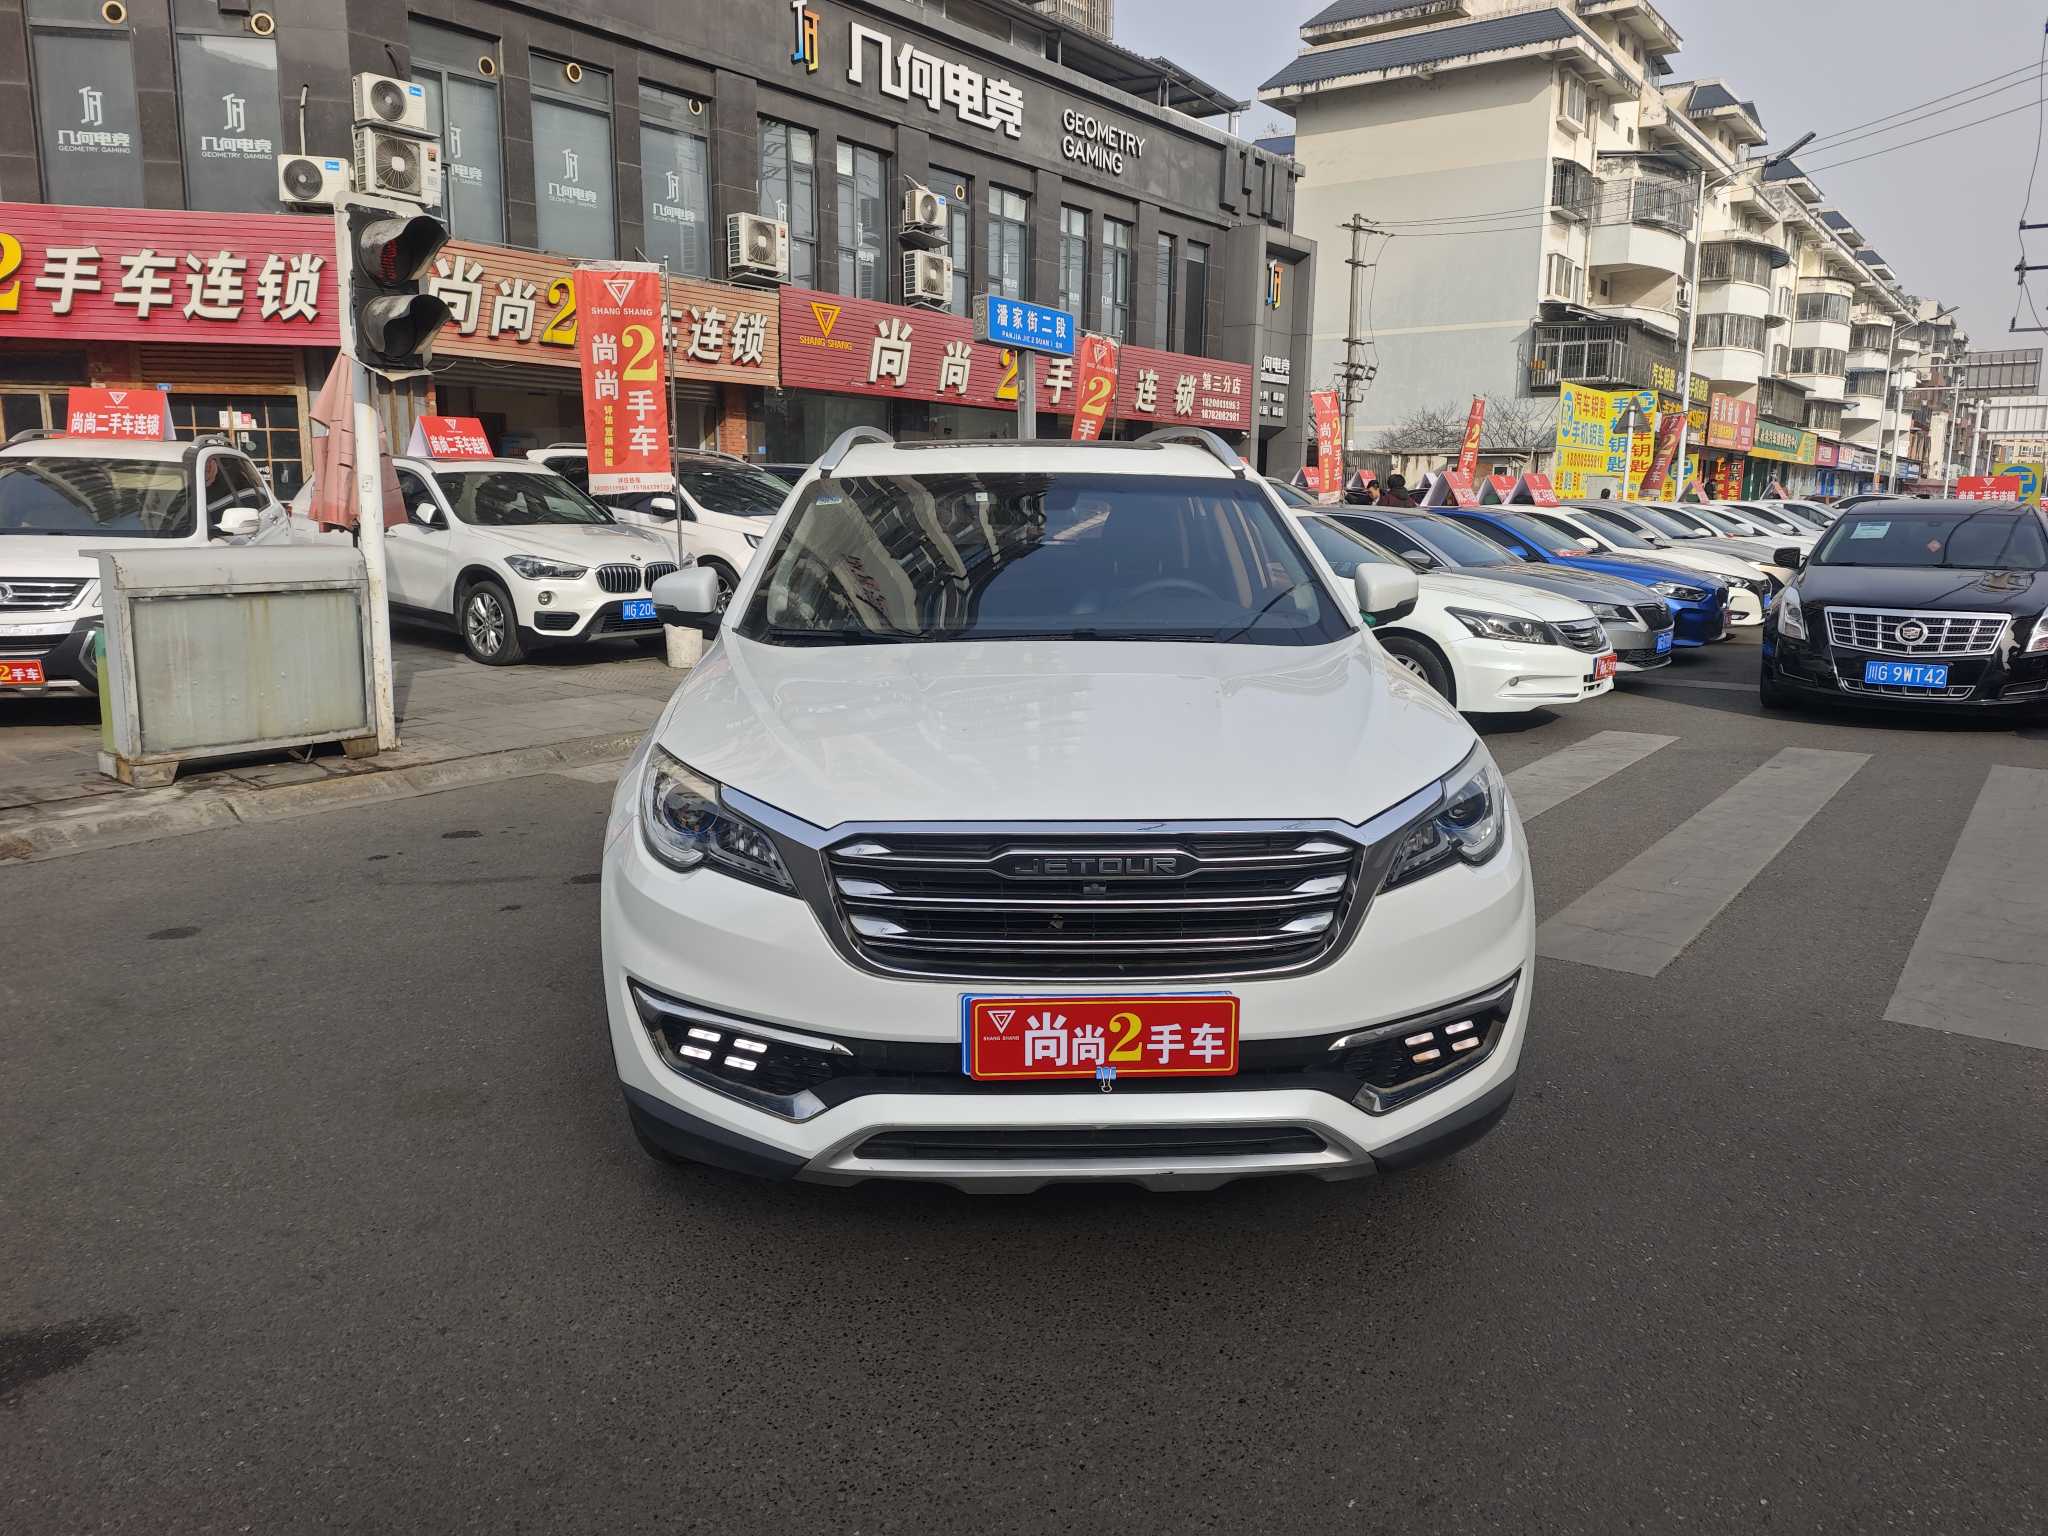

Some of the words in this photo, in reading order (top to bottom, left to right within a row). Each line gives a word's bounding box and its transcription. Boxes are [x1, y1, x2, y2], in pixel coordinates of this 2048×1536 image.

[849, 22, 1024, 138] 几何电竞
[57, 129, 131, 147] 几何电竞
[201, 136, 273, 153] 几何电竞
[1063, 108, 1146, 157] GEOMETRY
[201, 151, 241, 159] GEOMETRY
[1063, 135, 1124, 175] GAMING
[591, 307, 621, 315] SHANG
[623, 308, 653, 317] SHANG
[997, 303, 1066, 339] 潘家街二段
[799, 335, 826, 348] SHANG
[591, 333, 618, 401] 尚尚
[1202, 371, 1242, 395] 第三分店
[71, 411, 160, 436] 尚尚二手车连锁
[1013, 855, 1178, 876] JETOUR
[1024, 1011, 1226, 1067] 尚尚2手车
